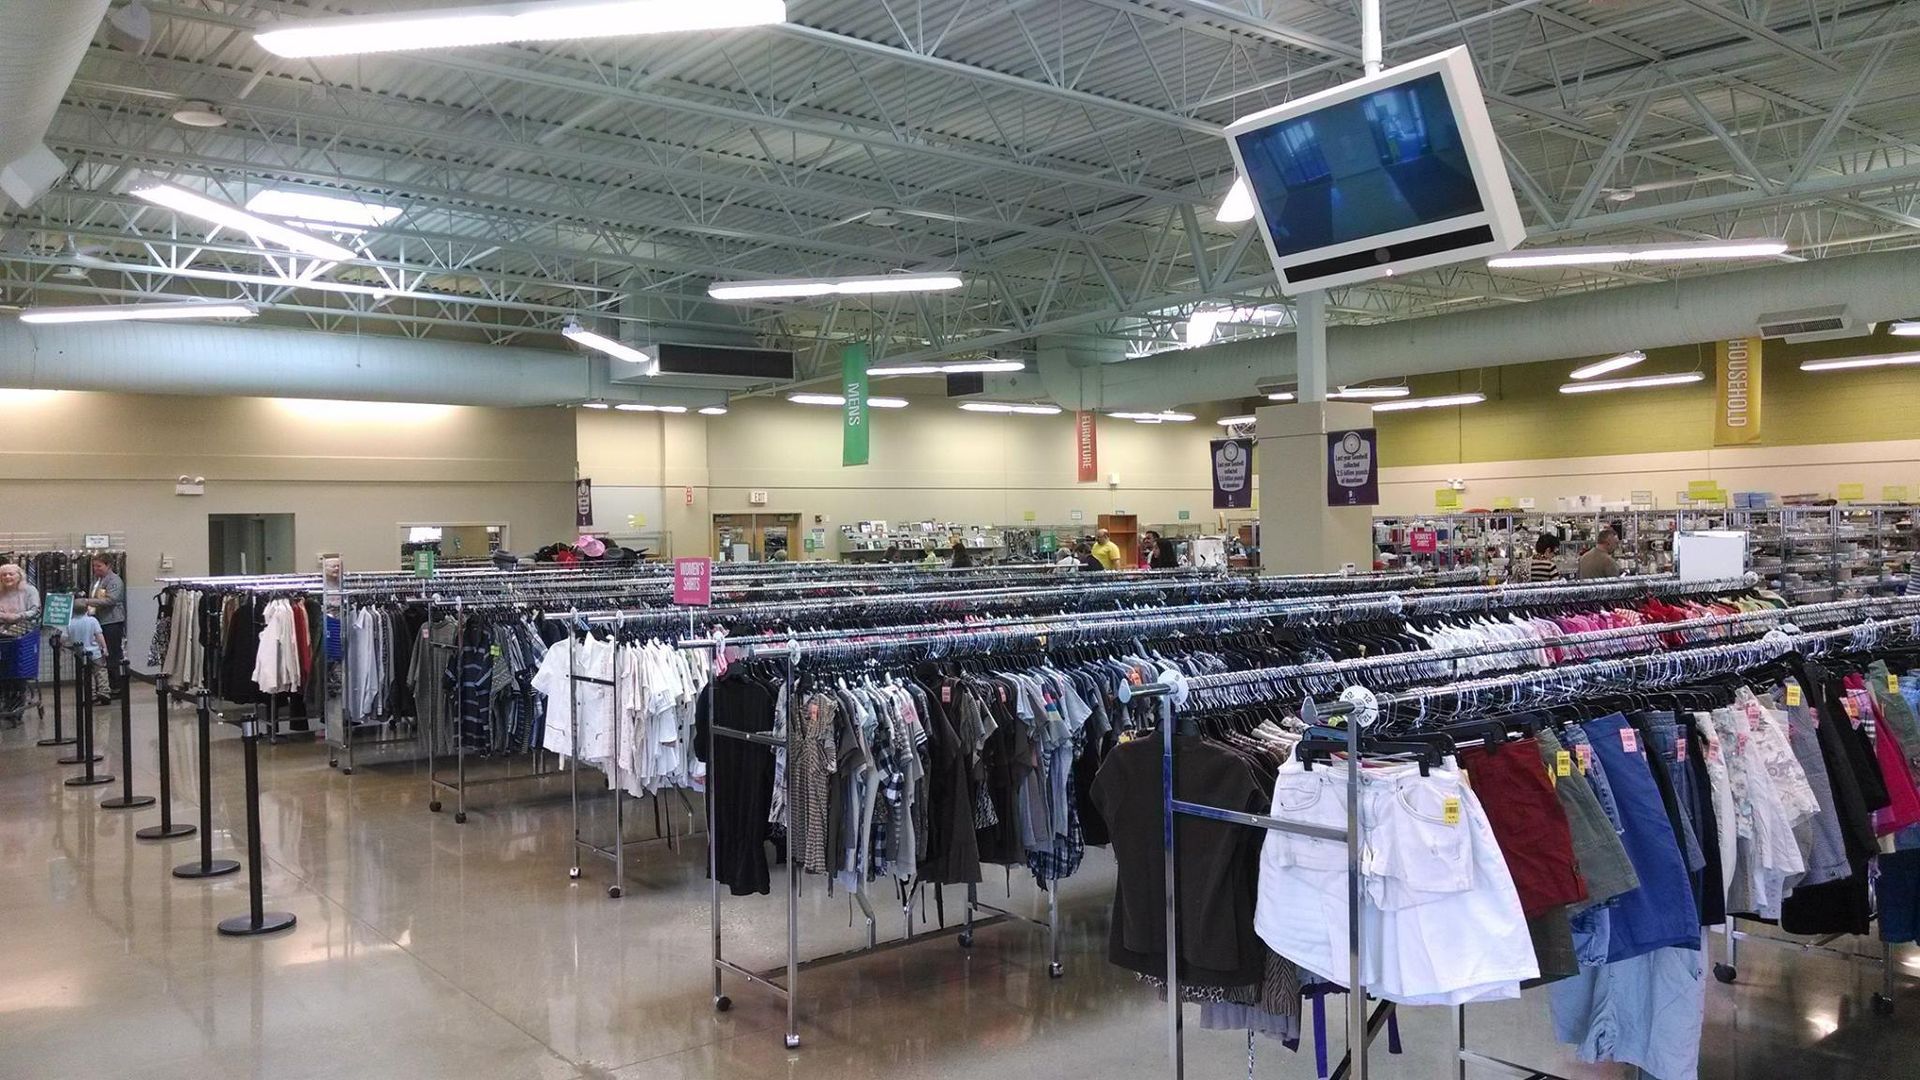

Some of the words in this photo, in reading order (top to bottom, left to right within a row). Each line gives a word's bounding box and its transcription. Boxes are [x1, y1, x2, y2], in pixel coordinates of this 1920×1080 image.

[848, 382, 861, 426] MENS
[1727, 339, 1748, 427] HOUSEHOLD
[1081, 415, 1092, 469] FURNITURE
[680, 562, 705, 576] WOMEN'S
[1363, 693, 1373, 705] 12
